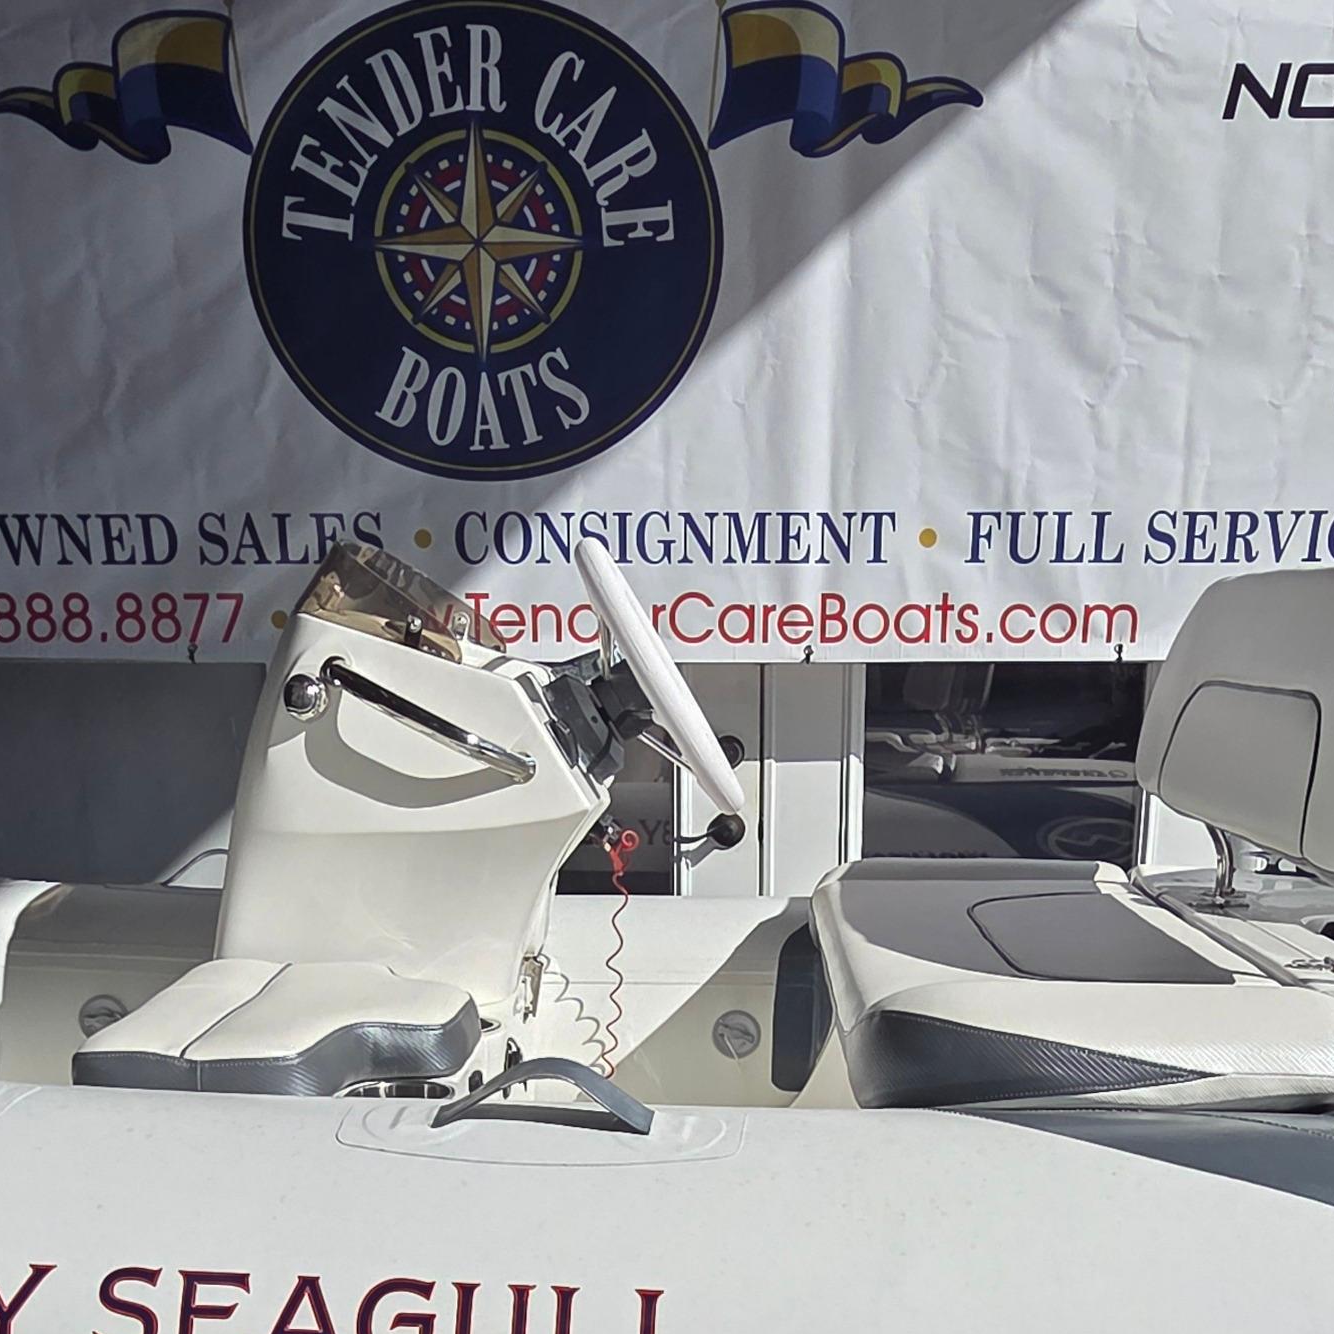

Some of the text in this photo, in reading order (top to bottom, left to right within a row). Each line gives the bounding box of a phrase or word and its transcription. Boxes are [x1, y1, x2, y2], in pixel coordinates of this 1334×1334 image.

[281, 23, 675, 247] TENDER CARE
[374, 346, 591, 452] BOATS
[198, 511, 384, 566] SALES
[455, 510, 896, 566] CONSIGNMENT
[965, 510, 1125, 564] FULL
